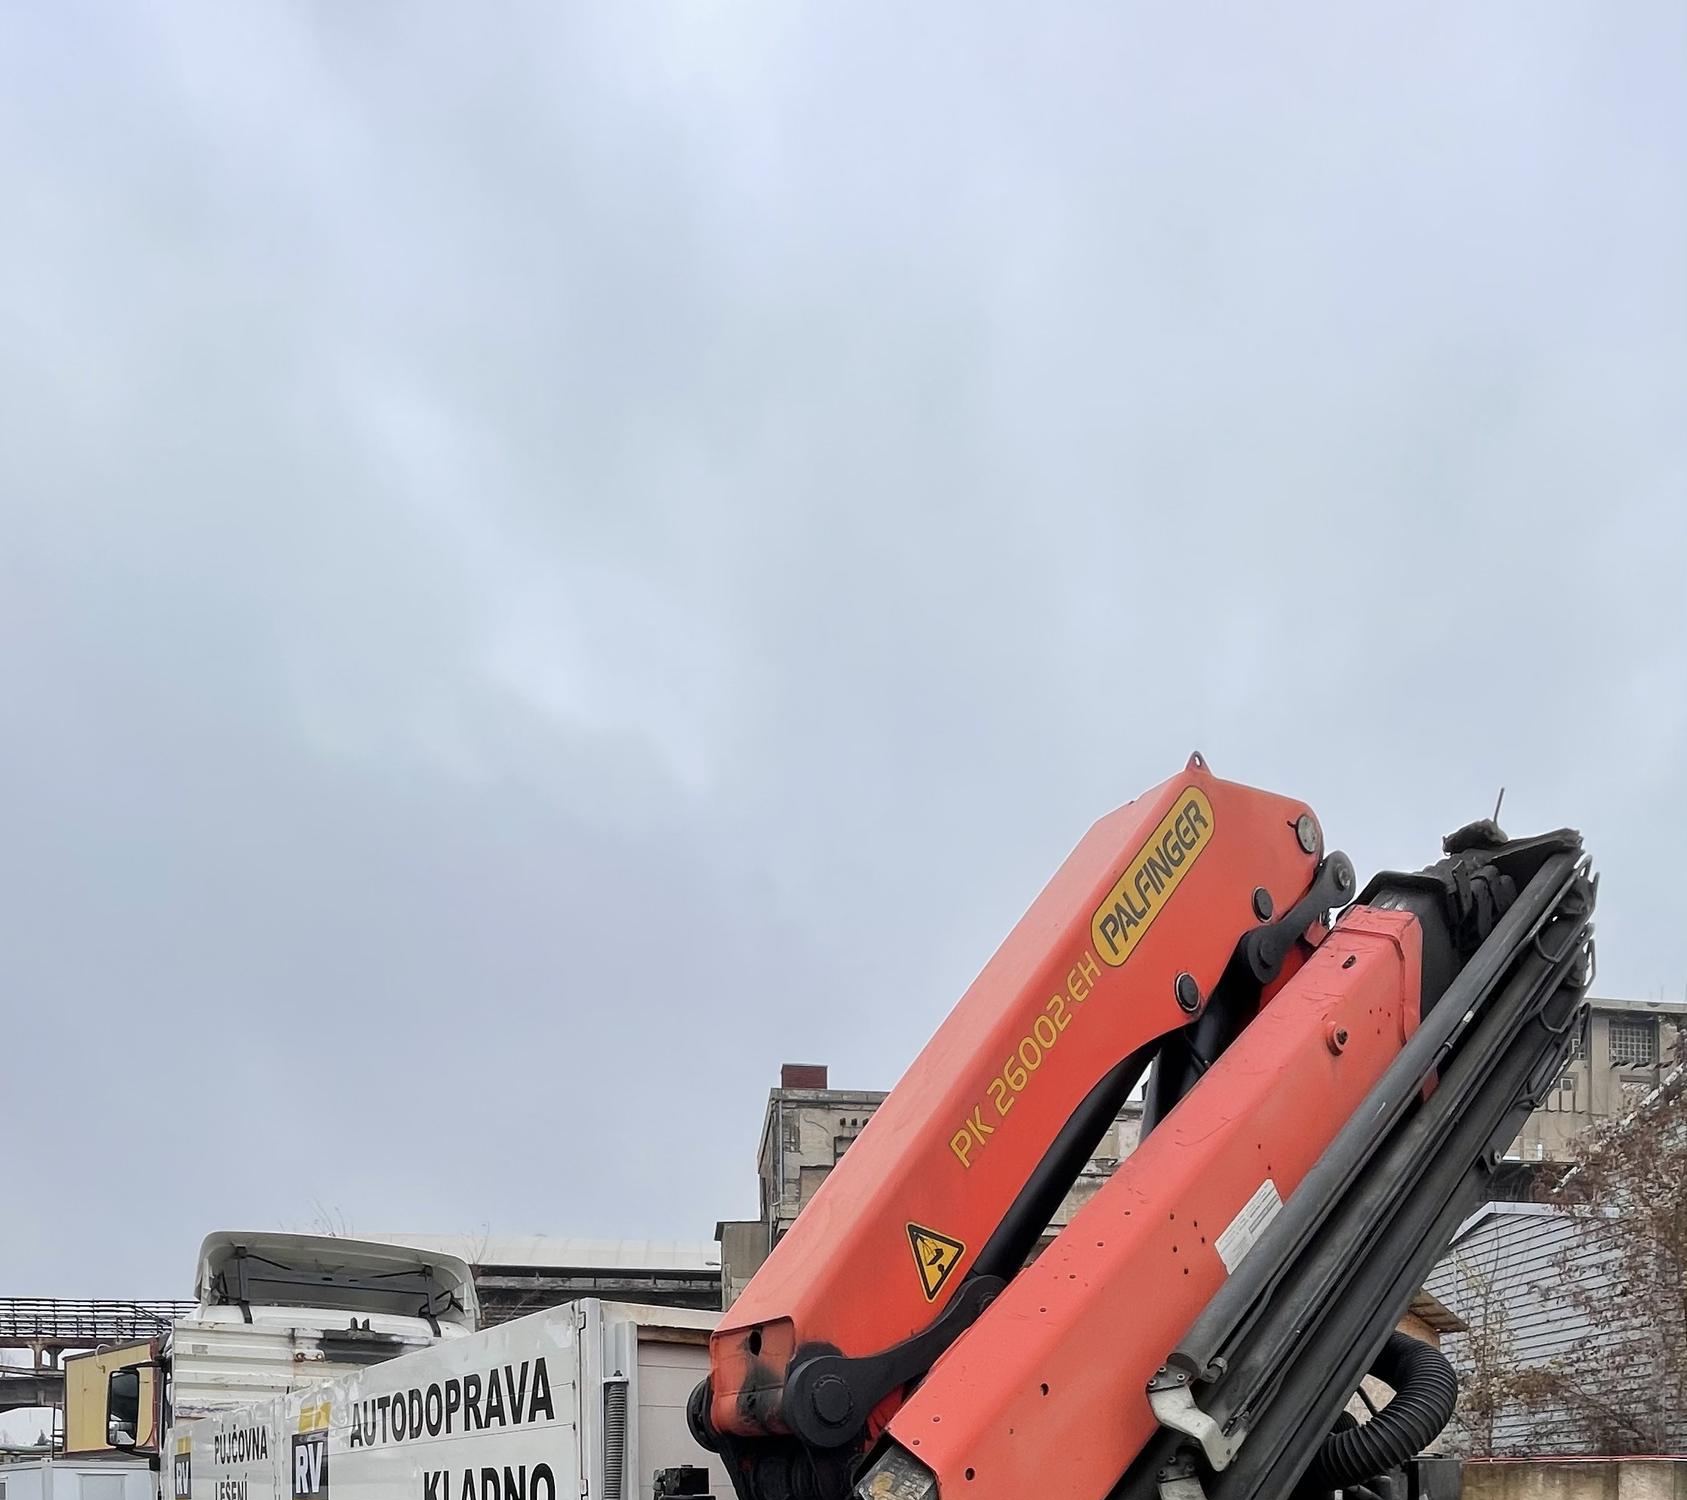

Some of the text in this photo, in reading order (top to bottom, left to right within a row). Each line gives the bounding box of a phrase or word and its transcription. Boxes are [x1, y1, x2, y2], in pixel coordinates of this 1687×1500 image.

[1099, 800, 1208, 956] PALFINGER
[950, 1104, 995, 1169] PK
[350, 1357, 555, 1448] AUTODOPRAVA
[214, 1423, 268, 1465] PŮJČOVNA
[295, 1441, 324, 1494] RV
[175, 1460, 190, 1495] RV
